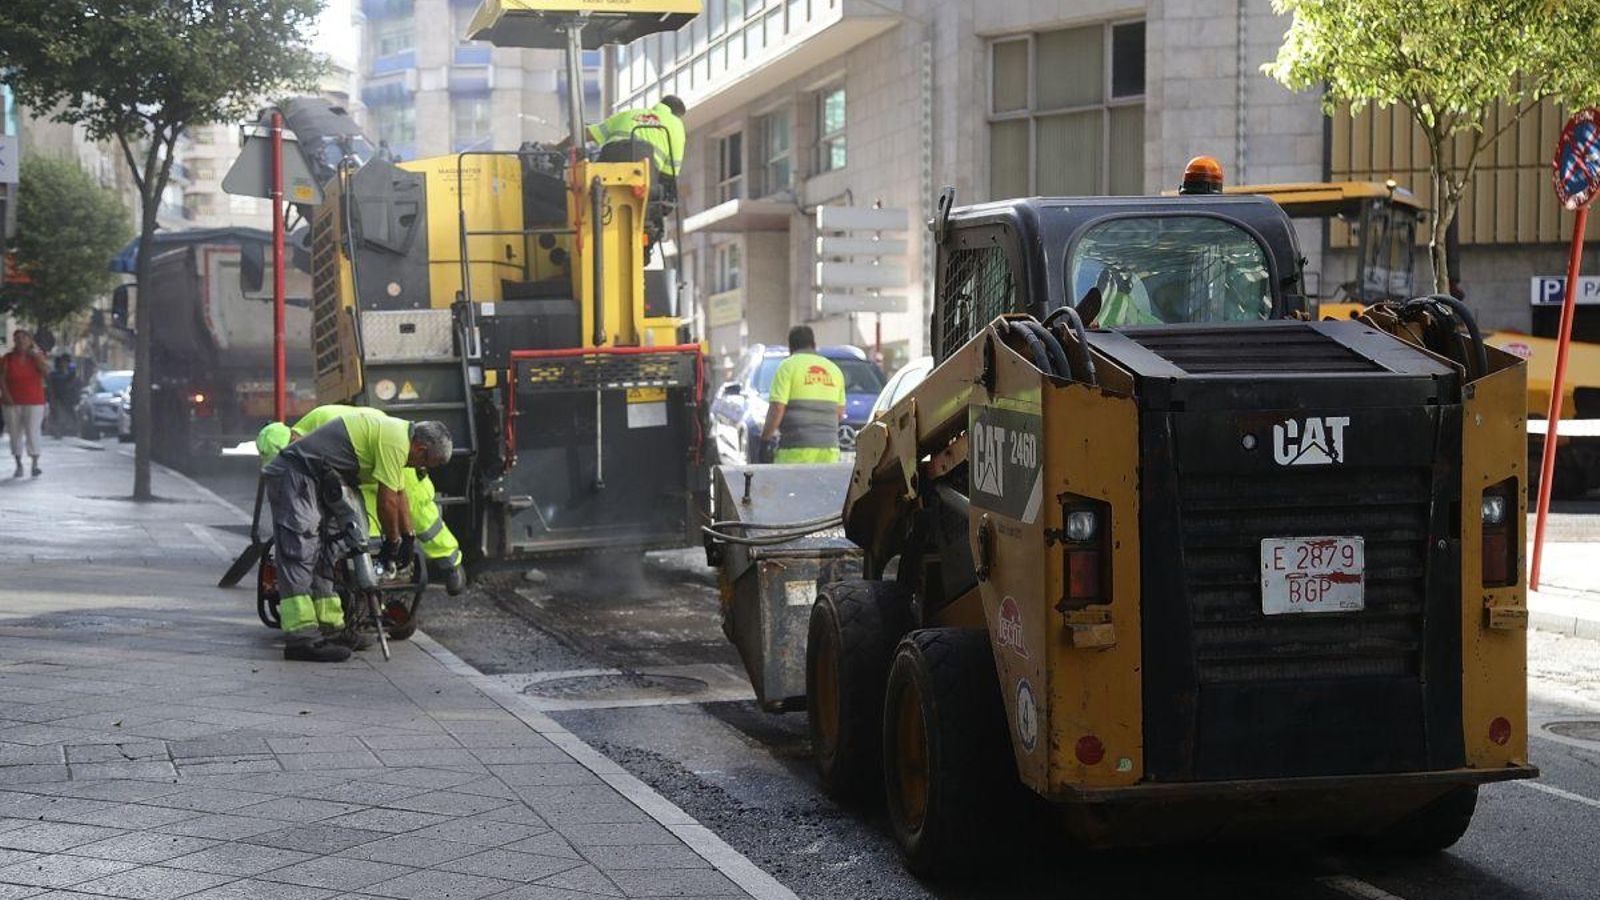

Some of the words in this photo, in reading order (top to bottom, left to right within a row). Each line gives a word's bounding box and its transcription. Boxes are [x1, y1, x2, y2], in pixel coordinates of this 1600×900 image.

[1544, 280, 1561, 303] P
[1273, 416, 1350, 466] CAT
[974, 421, 1005, 497] CAT
[1010, 430, 1037, 470] 246D
[1273, 547, 1286, 571] E
[1296, 544, 1355, 571] 2879
[1289, 579, 1332, 604] BGP
